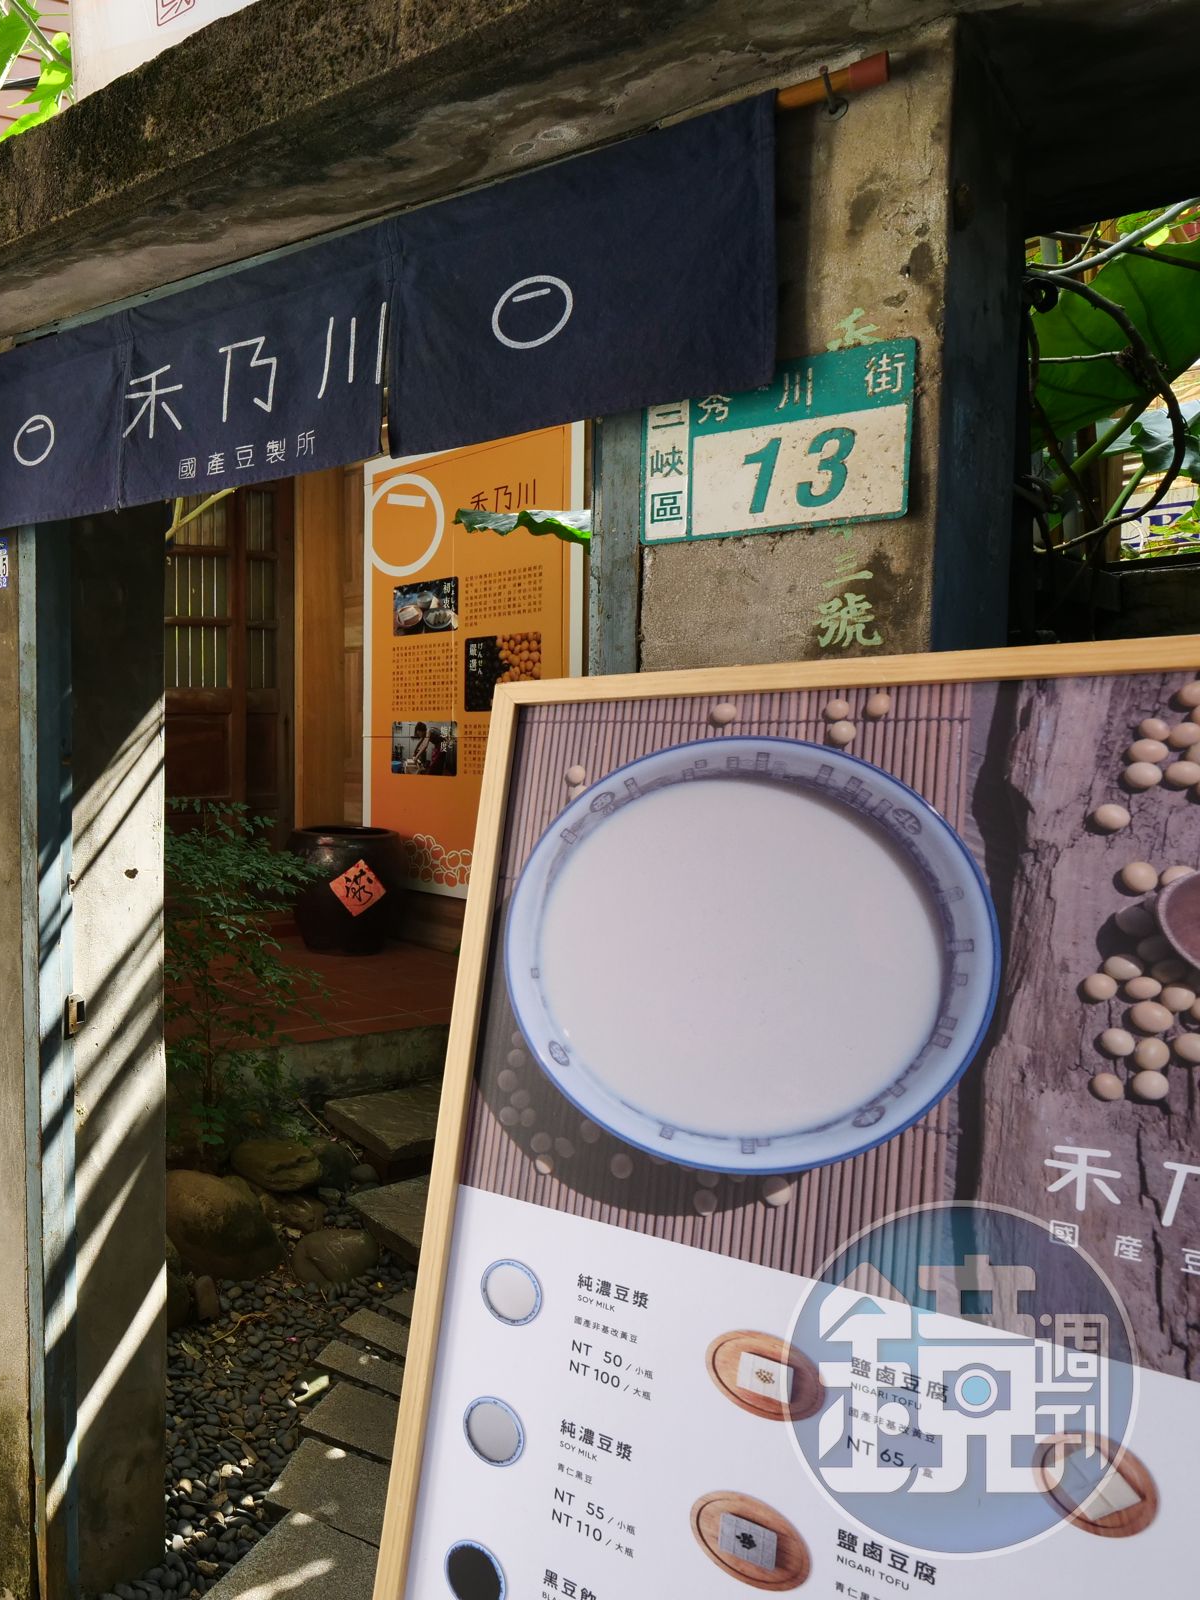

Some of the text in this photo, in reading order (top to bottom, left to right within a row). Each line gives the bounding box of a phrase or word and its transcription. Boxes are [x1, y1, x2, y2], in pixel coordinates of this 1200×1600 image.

[123, 300, 388, 440] 禾乃川
[178, 429, 316, 480] 國產豆製所
[742, 426, 857, 515] 13
[470, 478, 537, 513] 禾乃川
[577, 1273, 649, 1309] 純濃豆漿
[577, 1294, 615, 1312] SOY MILK
[573, 1315, 638, 1344] 國產非基改黃豆
[571, 1339, 593, 1357] NT
[603, 1350, 623, 1368] 50
[569, 1359, 590, 1377] NT
[594, 1368, 620, 1388] 100
[850, 1356, 949, 1403] 鹽鹵豆腐
[850, 1382, 922, 1411] NIGARI TOFU
[560, 1418, 632, 1461] 純濃豆漿
[560, 1440, 597, 1461] SOY MILK
[847, 1435, 875, 1456] NT
[880, 1448, 905, 1467] 65
[557, 1462, 593, 1484] 青仁黑豆
[554, 1487, 575, 1506] NT
[585, 1501, 604, 1520] 55
[551, 1508, 573, 1527] NT
[576, 1520, 602, 1542] 110
[836, 1528, 938, 1586] 鹽鹵豆腐
[836, 1554, 910, 1591] NIGARI TOFU
